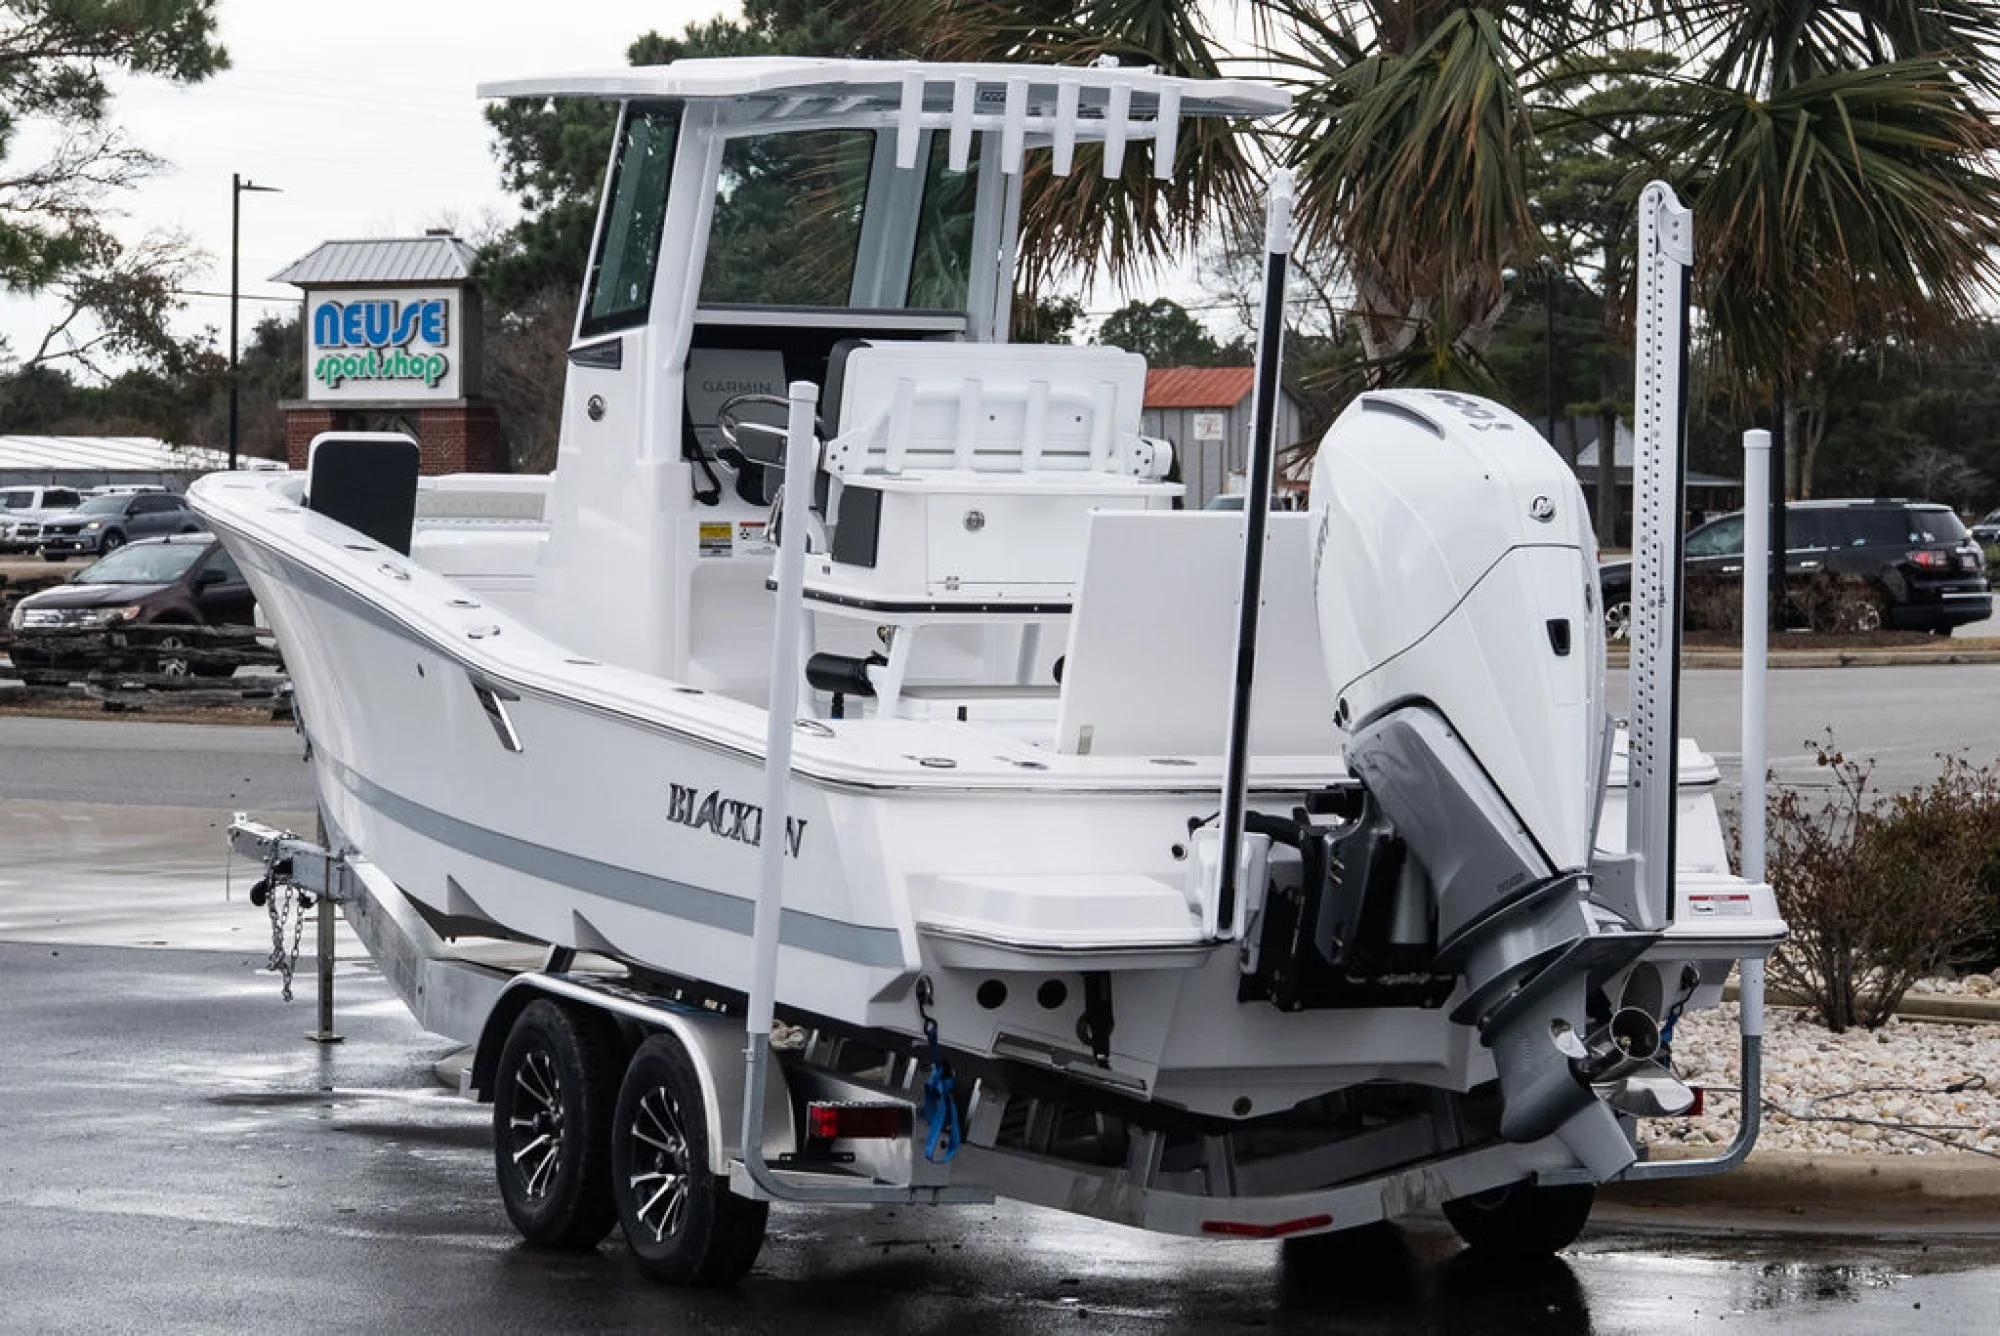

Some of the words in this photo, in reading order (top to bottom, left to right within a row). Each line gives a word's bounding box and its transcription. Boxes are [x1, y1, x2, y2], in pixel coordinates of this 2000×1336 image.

[314, 300, 447, 346] NEUSE
[315, 350, 378, 388] sport
[382, 348, 446, 388] shop
[703, 381, 772, 394] GARMIN
[666, 782, 808, 859] BLACKN
